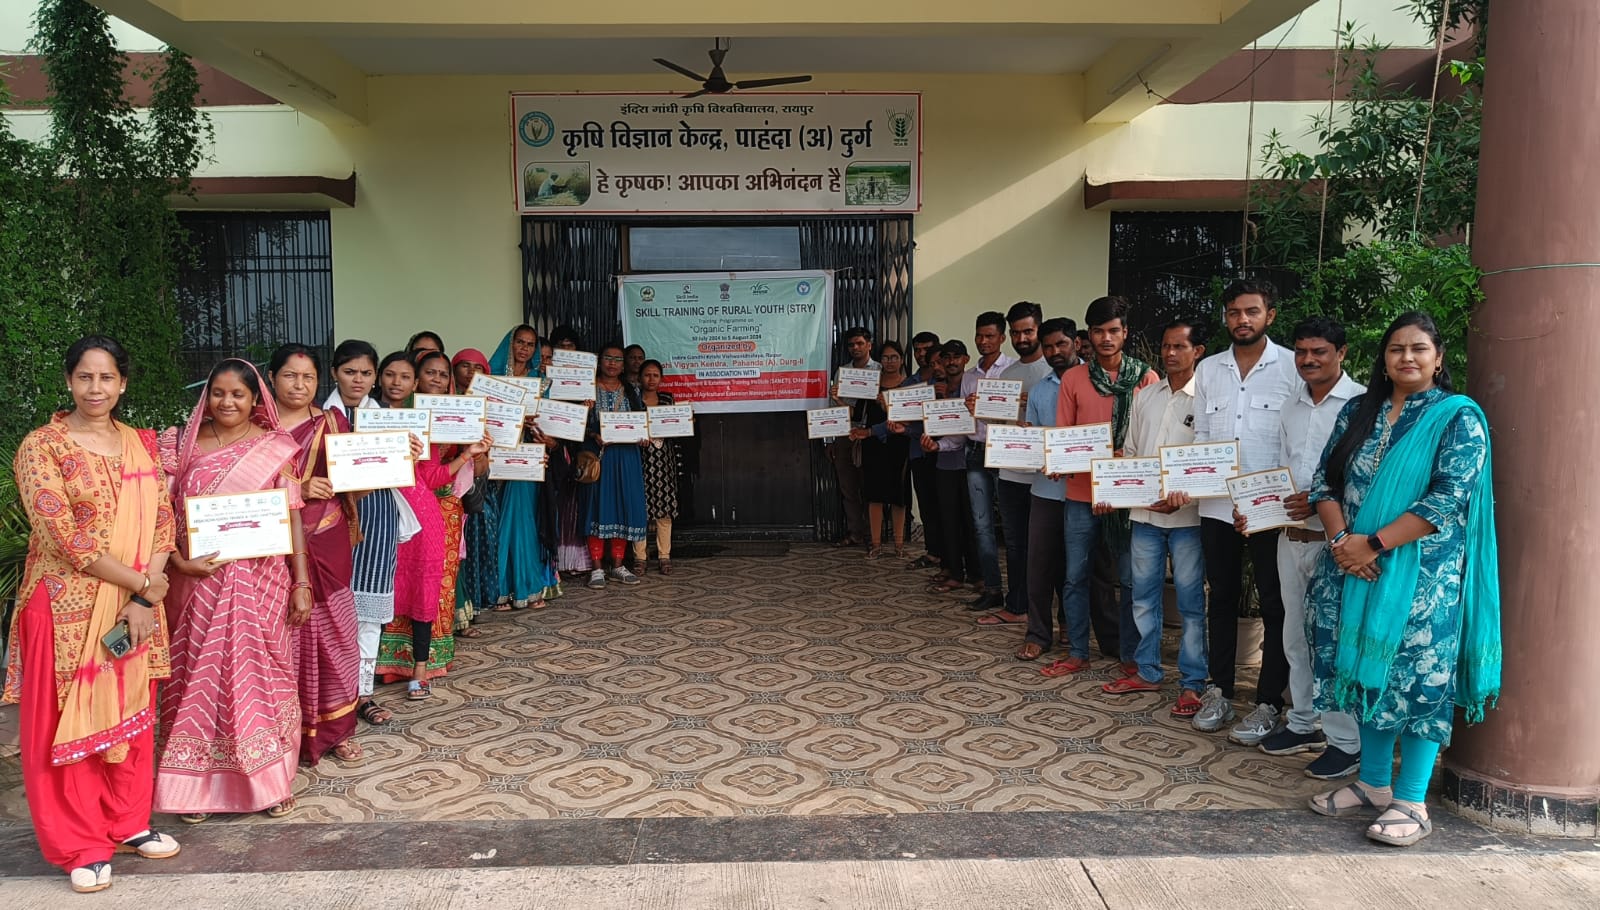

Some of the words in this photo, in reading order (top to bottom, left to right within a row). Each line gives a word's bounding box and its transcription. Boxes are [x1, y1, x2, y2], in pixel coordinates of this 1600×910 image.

[620, 102, 648, 115] इंदिरा
[652, 102, 678, 114] गांधी
[681, 102, 704, 116] कृषि
[782, 104, 814, 116] रायपुर
[561, 120, 604, 157] कृषि
[610, 120, 673, 150] विज्ञान
[678, 120, 728, 151] केन्द्र,
[735, 120, 792, 150] पाहंदा
[799, 124, 833, 151] (अ)
[840, 120, 873, 158] दुर्ग
[597, 169, 609, 193] हे
[614, 174, 672, 198] कृषक!
[678, 173, 740, 191] आपका
[745, 167, 823, 192] अभिनंदन
[828, 167, 841, 193] है
[635, 308, 660, 318] SKILL
[663, 307, 705, 317] TRAINING
[707, 306, 719, 316] OF
[722, 305, 752, 315] RURAL
[754, 305, 784, 314] YOUTH
[787, 303, 816, 316] (STRY)
[702, 343, 740, 352] Organized
[743, 343, 752, 351] by
[674, 361, 698, 369] Vigyan
[701, 360, 728, 368] Kendra,
[733, 359, 764, 367] Pahanda
